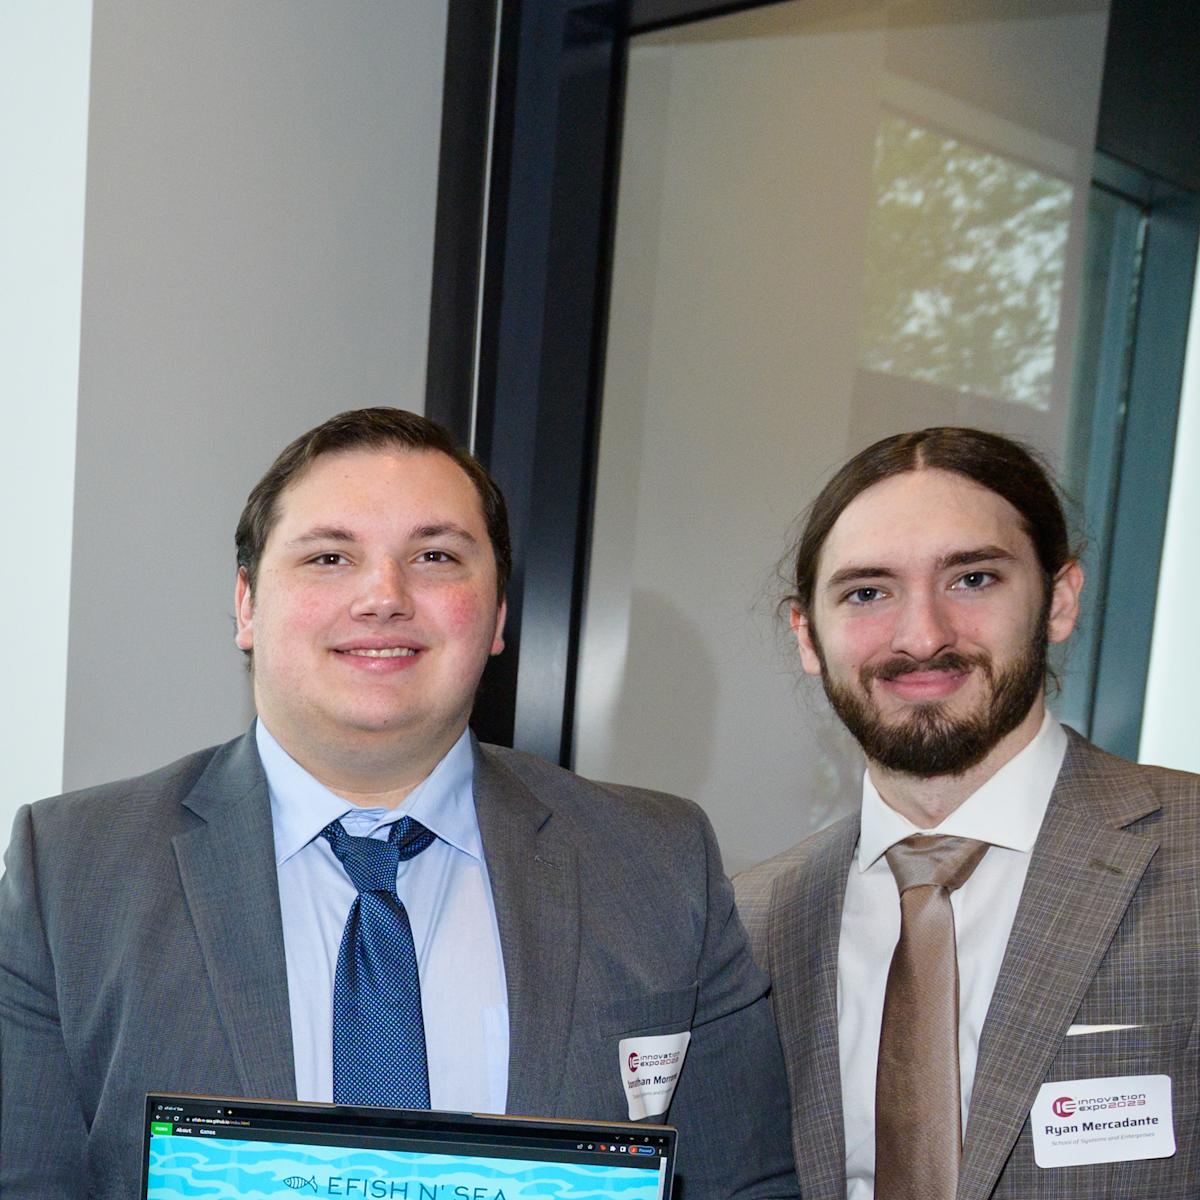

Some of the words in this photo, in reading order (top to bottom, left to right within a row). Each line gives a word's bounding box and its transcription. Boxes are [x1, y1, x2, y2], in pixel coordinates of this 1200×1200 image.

[1078, 1093, 1146, 1105] innovation
[1078, 1099, 1146, 1112] expo2023
[1045, 1124, 1078, 1137] Ryan
[1082, 1116, 1159, 1132] Mercadante
[328, 1177, 408, 1200] EFISH
